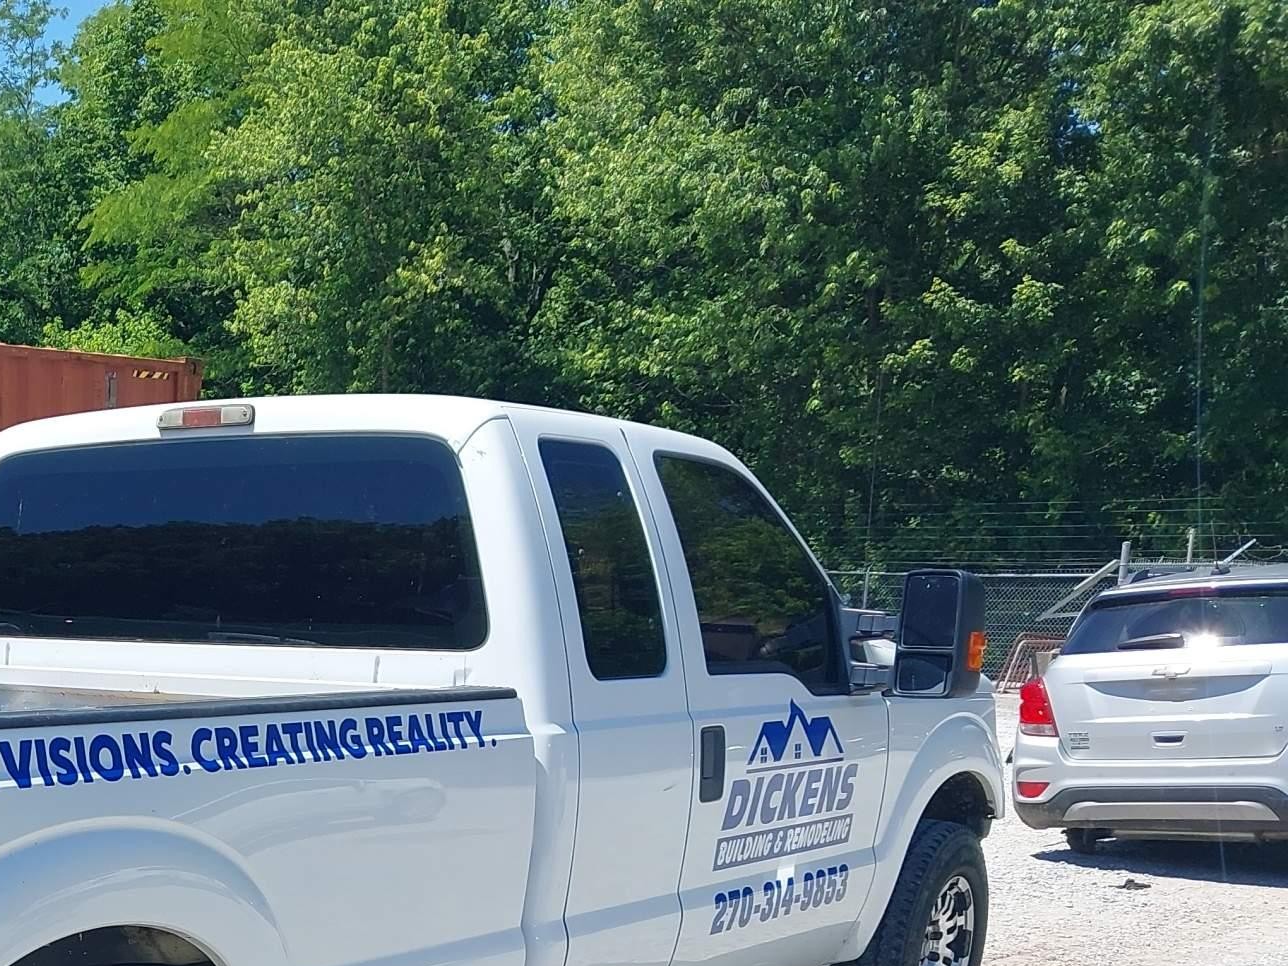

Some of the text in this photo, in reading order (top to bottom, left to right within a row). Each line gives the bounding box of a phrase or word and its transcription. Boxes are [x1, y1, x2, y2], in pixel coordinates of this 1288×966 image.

[191, 717, 367, 773] CREATING
[365, 710, 497, 757] REALITY.
[721, 763, 859, 831] DICKENS
[717, 817, 851, 866] BUILDING & REMODELING
[710, 863, 849, 935] 270-314-9853
